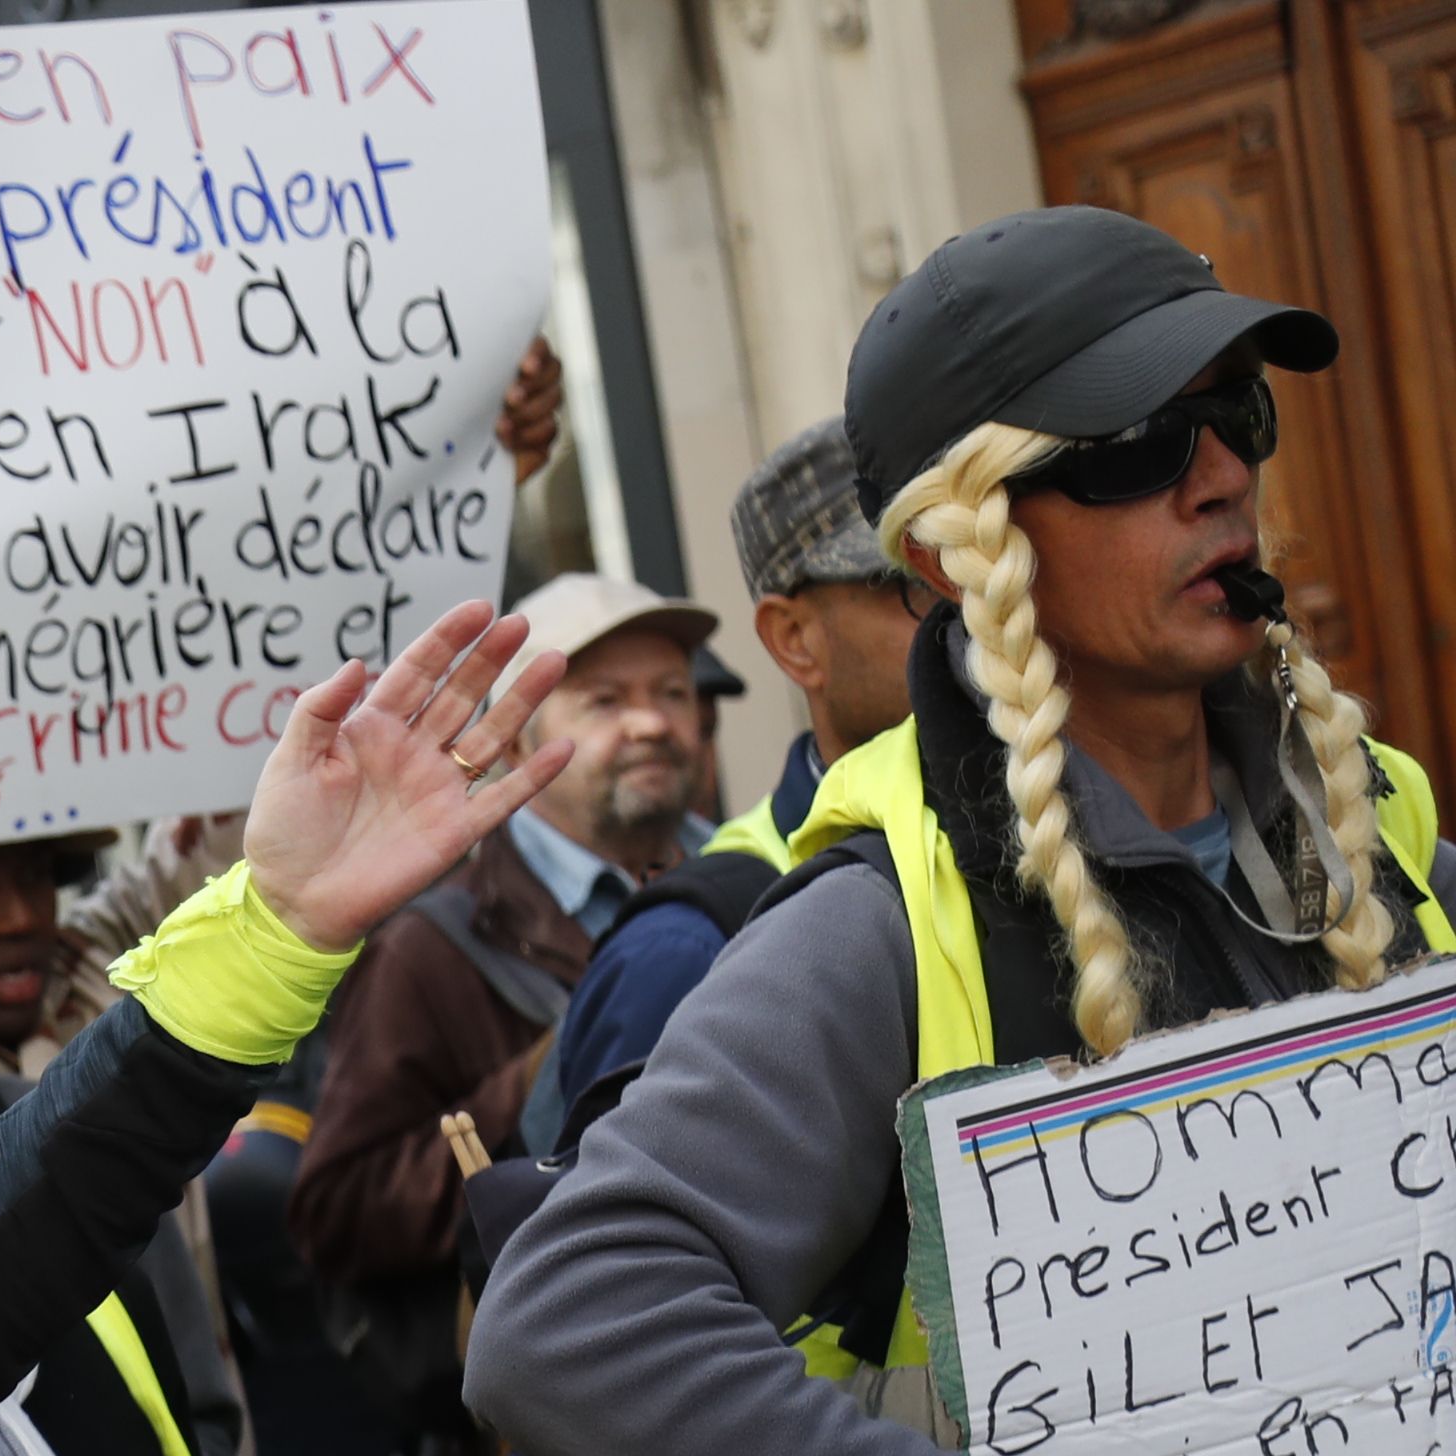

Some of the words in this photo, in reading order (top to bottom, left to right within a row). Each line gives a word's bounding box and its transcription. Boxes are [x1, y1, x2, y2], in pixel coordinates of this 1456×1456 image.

[166, 11, 435, 150] paix
[237, 252, 318, 358] à
[345, 236, 461, 364] la
[234, 446, 494, 579] déclaré
[335, 580, 413, 665] et
[983, 1165, 1342, 1349] président
